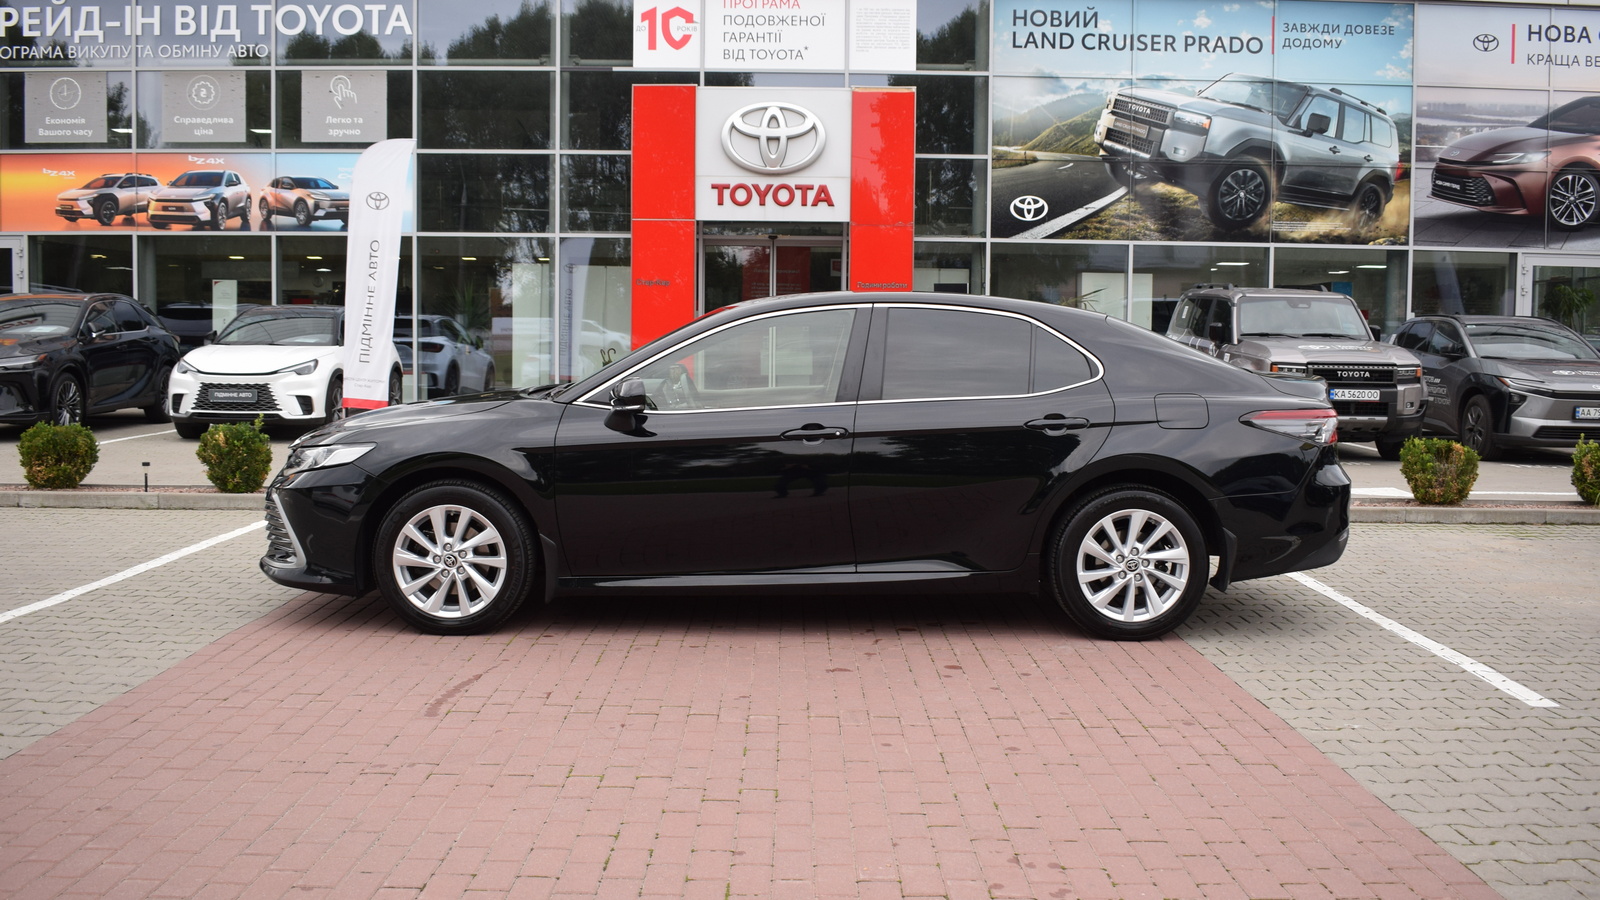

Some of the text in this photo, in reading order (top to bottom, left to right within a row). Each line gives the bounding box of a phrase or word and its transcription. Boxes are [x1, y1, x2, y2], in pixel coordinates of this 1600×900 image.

[723, 0, 801, 9] ПРОГРАМА
[0, 0, 413, 43] РЕЙД-ІН ВІД TOYOTA
[723, 12, 827, 28] ПОДОВЖЕНОЇ
[1012, 6, 1098, 29] НОВИЙ
[1282, 22, 1395, 36] ЗАВЖДИ ДОВЕЗЕ
[1527, 24, 1592, 44] НОВА
[723, 29, 783, 43] ГАРАНТІЇ
[1012, 31, 1264, 55] LAND CRUISER PRADO
[1282, 38, 1343, 50] ДОДОМУ
[0, 43, 269, 60] ОГРАМА ВИКУПУ ТА ОБМІНУ АВТО
[723, 48, 746, 62] ВІД
[1526, 53, 1600, 69] КРАЩА ВЕ
[1127, 102, 1151, 115] TOYOTA
[45, 116, 86, 126] Економія
[173, 115, 235, 127] Справедлива
[325, 115, 352, 125] Легко
[38, 128, 93, 138] Вашого часу
[194, 127, 214, 137] ціна
[328, 128, 361, 137] зручно
[711, 183, 835, 207] TOYOTA
[358, 239, 381, 364] ПІДМІННЕ АВТО
[1337, 370, 1371, 378] TOYOTA
[1334, 390, 1379, 399] KA 5620 OO
[1580, 408, 1592, 417] AA
